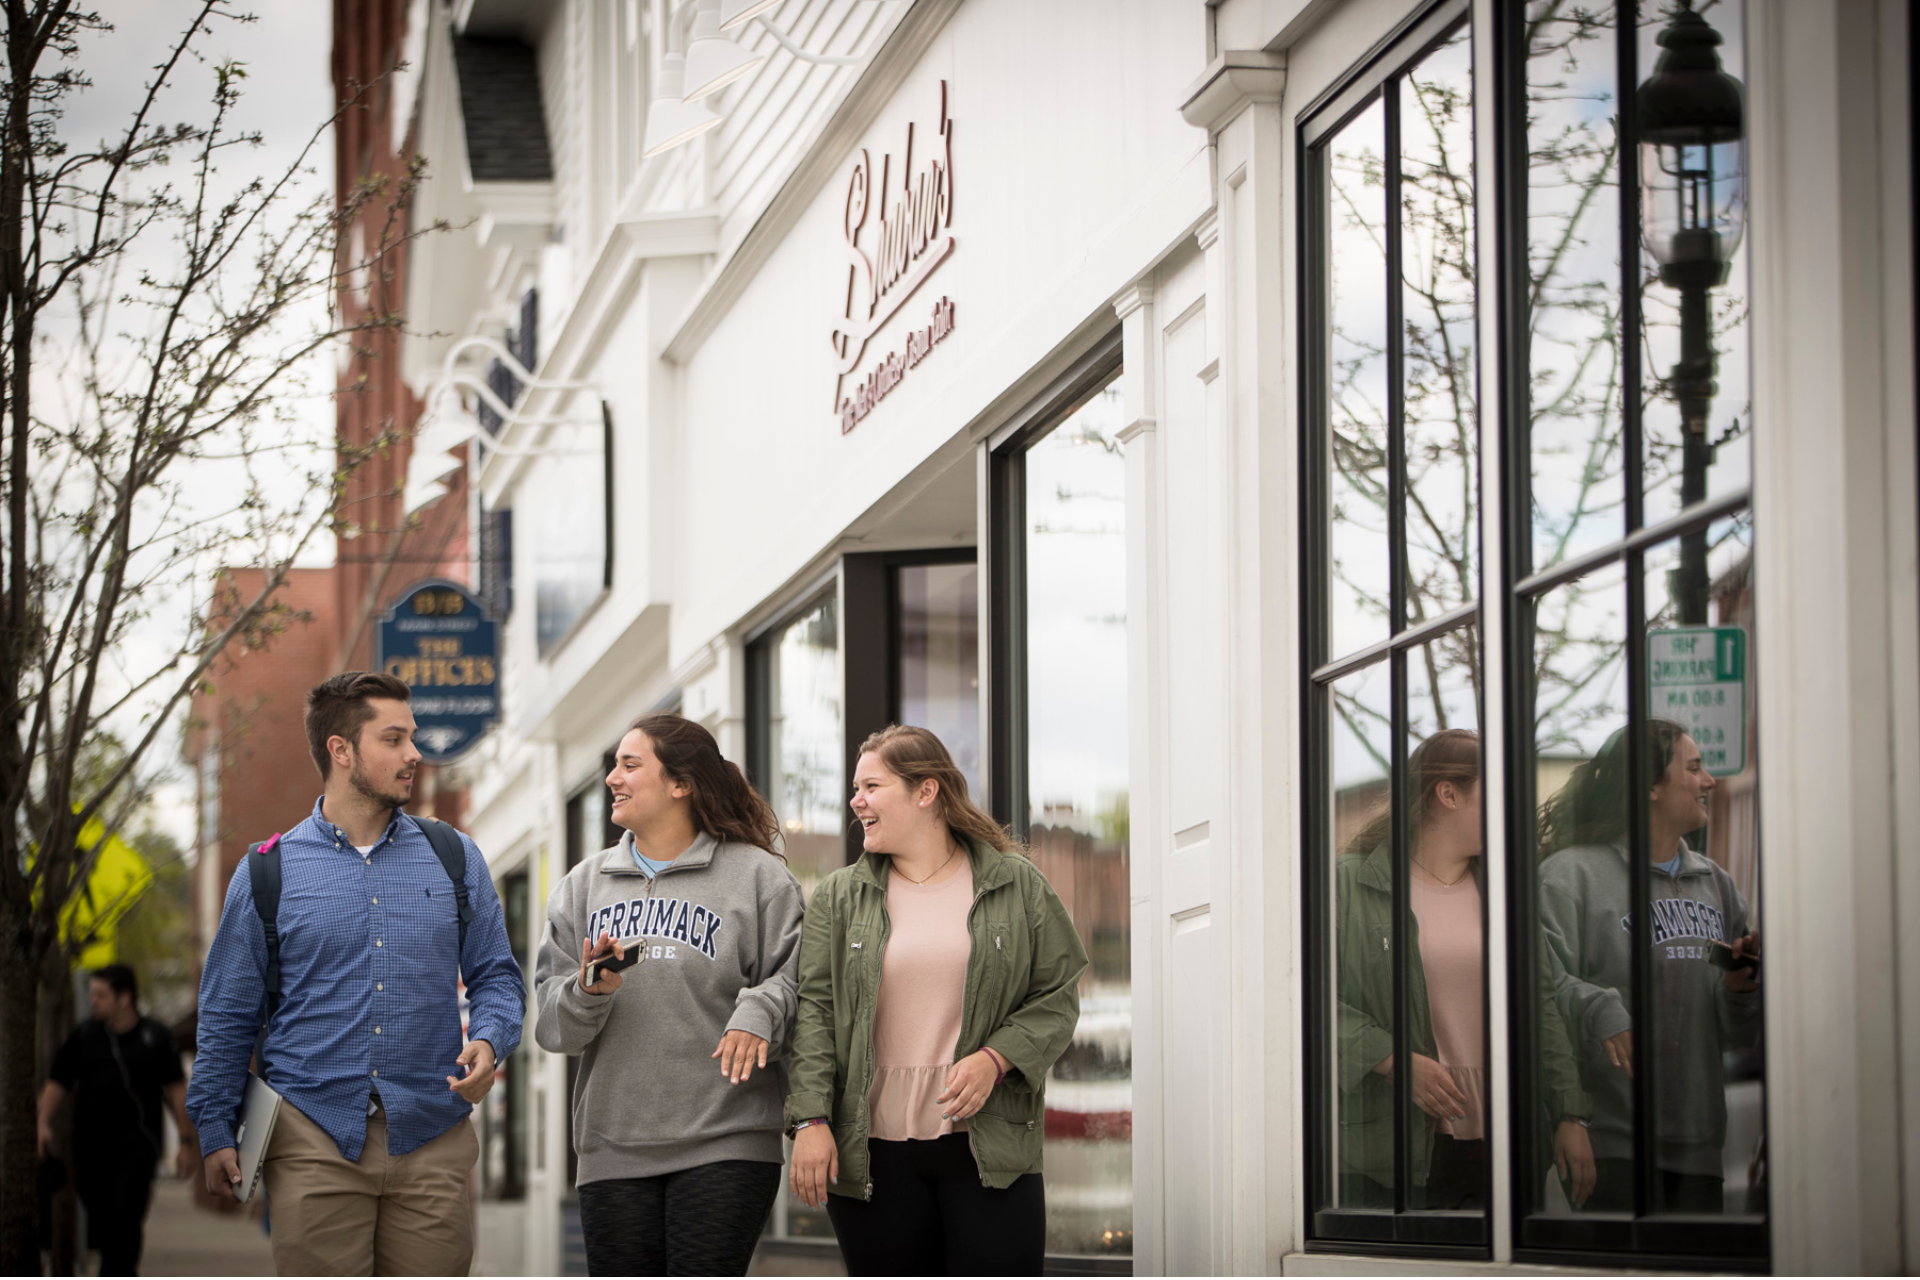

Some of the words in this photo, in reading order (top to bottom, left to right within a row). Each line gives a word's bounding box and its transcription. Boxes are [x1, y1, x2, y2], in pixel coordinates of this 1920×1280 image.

[418, 637, 461, 657] THE
[385, 656, 495, 686] OFFICES
[446, 698, 494, 713] FLOOR
